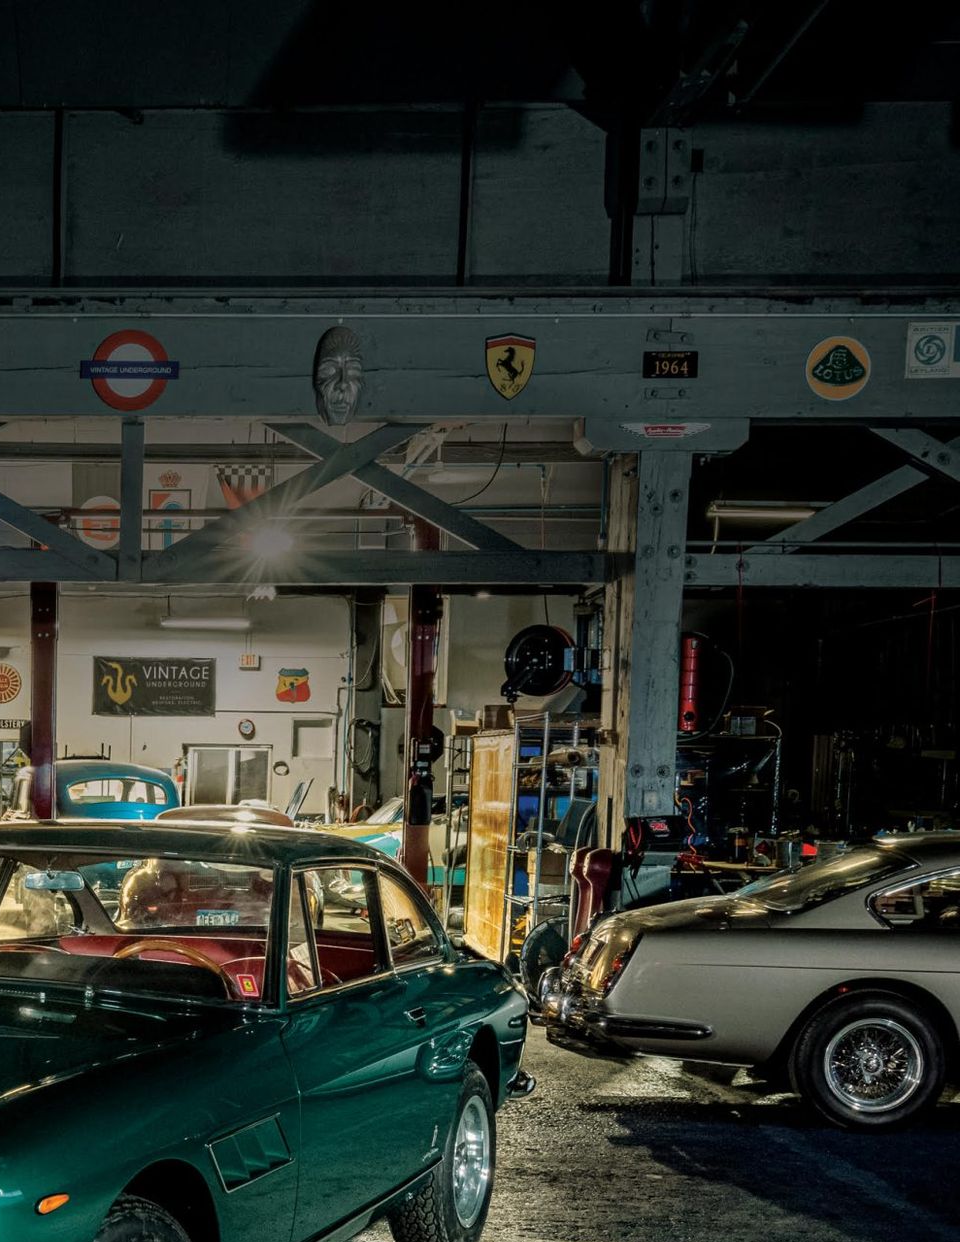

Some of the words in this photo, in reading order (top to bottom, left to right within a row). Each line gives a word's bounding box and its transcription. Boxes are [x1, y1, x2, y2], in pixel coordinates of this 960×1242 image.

[90, 366, 118, 374] VINTAGE
[120, 366, 172, 374] UNDERGROUND
[655, 360, 689, 375] 1964
[814, 364, 864, 381] LOTUS
[142, 666, 210, 680] VINTAGE
[146, 680, 206, 688] UNDERGROUND
